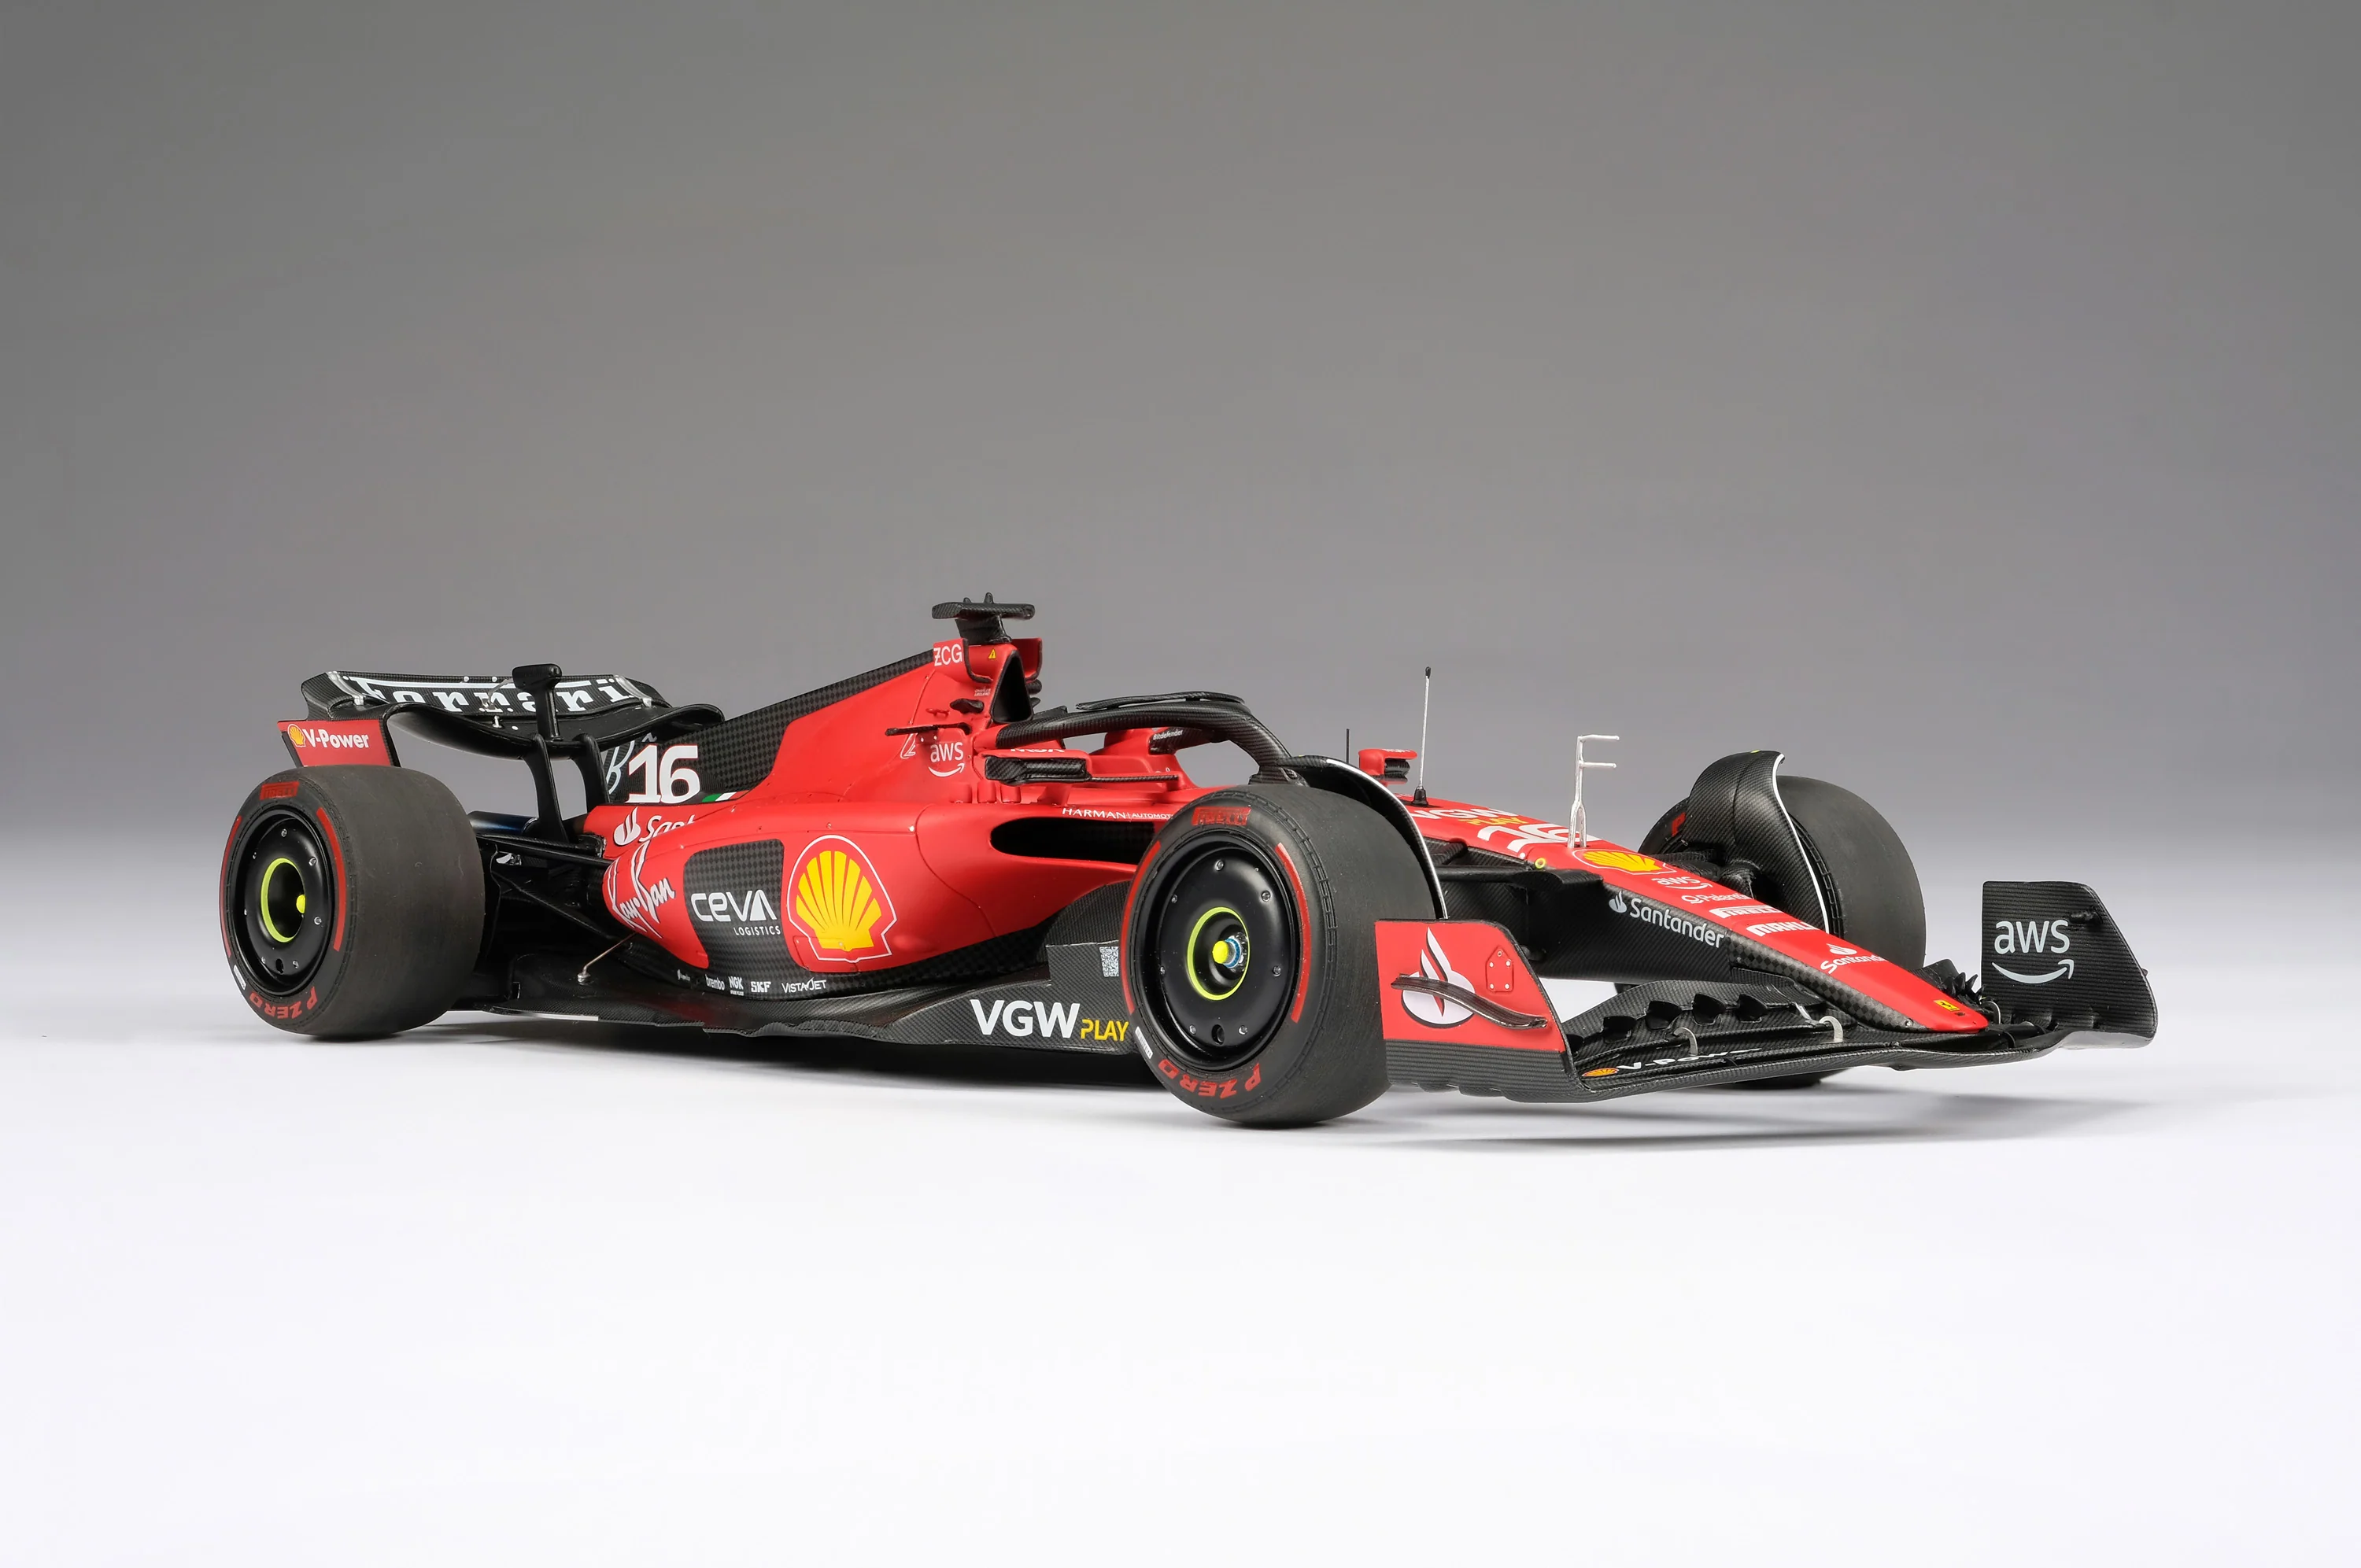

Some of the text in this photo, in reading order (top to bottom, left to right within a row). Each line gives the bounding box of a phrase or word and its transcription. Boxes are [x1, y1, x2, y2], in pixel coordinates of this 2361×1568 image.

[933, 644, 963, 666] ZCG
[302, 729, 369, 748] V-Power
[1153, 729, 1183, 740] Bitdefender
[930, 742, 964, 762] aws
[626, 743, 700, 803] 16
[1062, 807, 1126, 819] HARMAN
[733, 926, 781, 936] LOGISTICS
[1629, 898, 1724, 948] Santander
[1994, 920, 2070, 954] aws
[705, 974, 725, 991] brembo
[729, 976, 744, 990] NGK
[751, 981, 771, 993] SKF
[249, 987, 318, 1019] P ZERO
[970, 999, 1129, 1042] VGW PLAY
[1158, 1059, 1261, 1098] P ZERO
